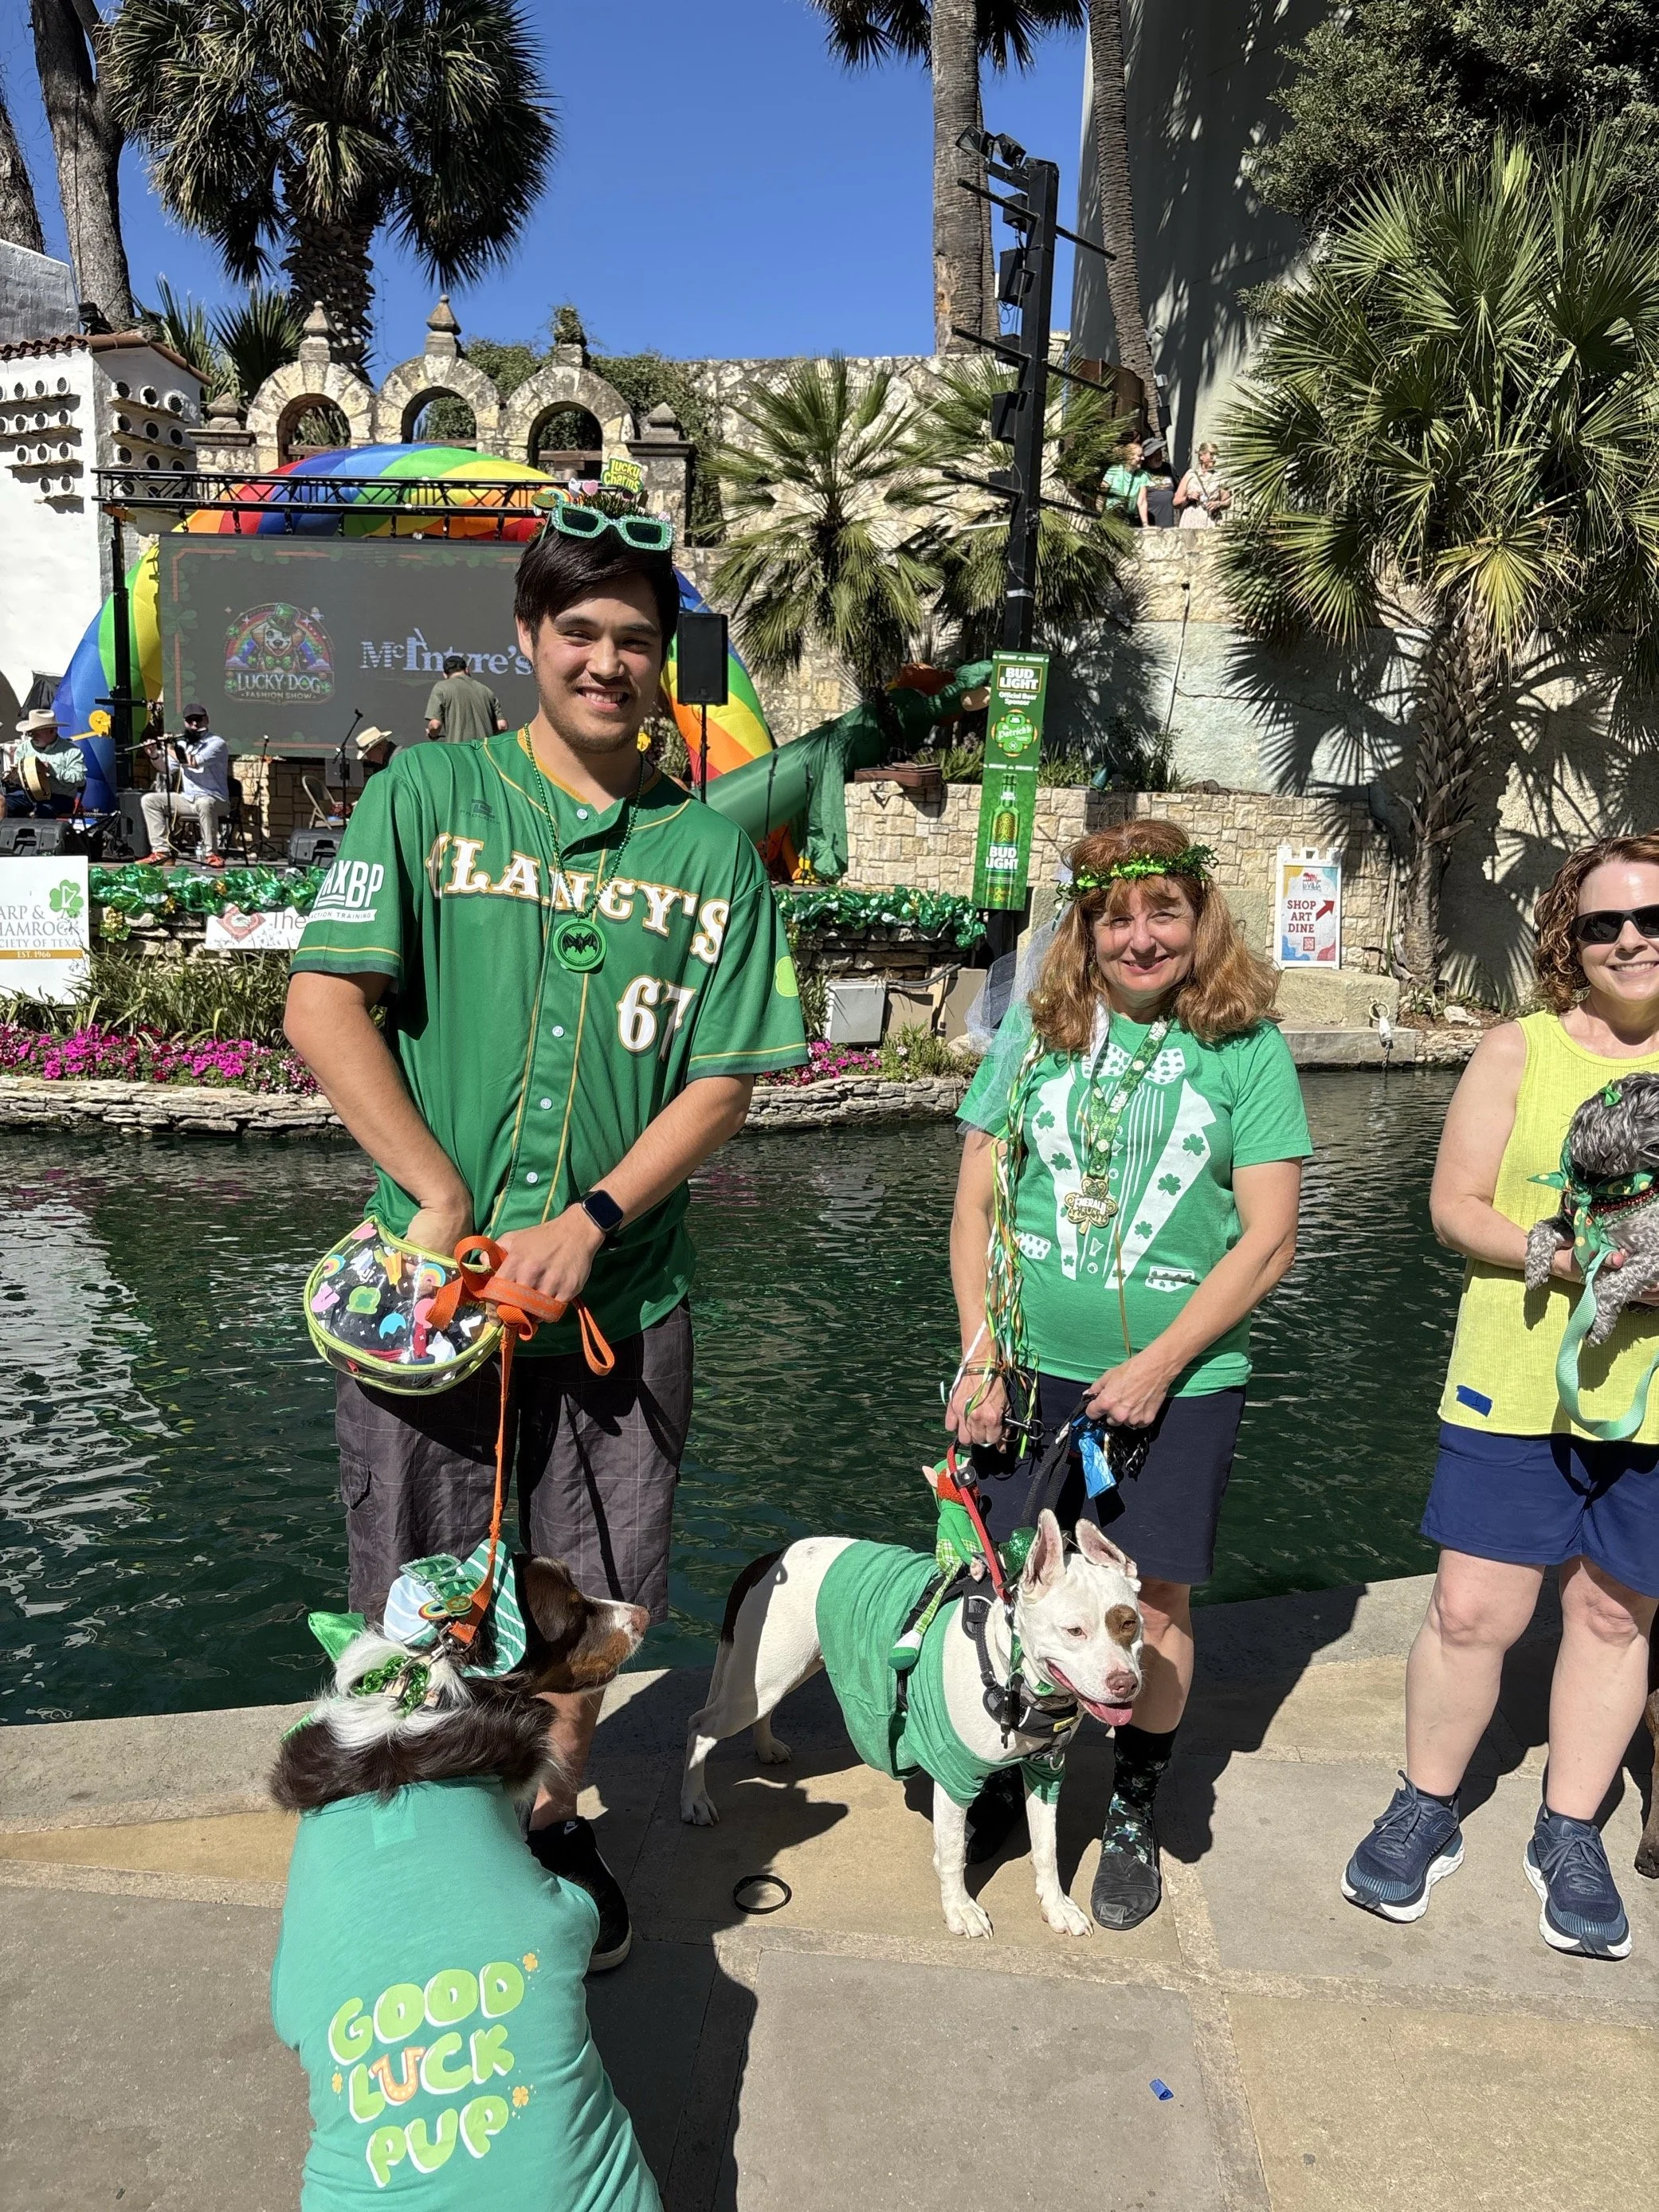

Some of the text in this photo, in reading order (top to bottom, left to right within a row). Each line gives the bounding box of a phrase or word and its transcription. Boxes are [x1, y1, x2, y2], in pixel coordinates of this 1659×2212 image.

[603, 472, 641, 493] Charms
[1005, 667, 1034, 679] BUD
[237, 673, 320, 693] LUCKY DOG
[999, 677, 1038, 690] LIGHT
[989, 846, 1017, 858] BUD
[985, 857, 1019, 870] LIGHT
[313, 860, 384, 908] AXBP
[33, 904, 45, 920] &
[1287, 900, 1316, 910] SHOP
[1290, 912, 1312, 922] ART
[1288, 924, 1315, 933] DINE
[33, 939, 46, 948] OF
[1073, 1198, 1107, 1215] EMERALD
[328, 1961, 524, 2065] GOOD
[349, 2024, 515, 2124] LUCK
[366, 2095, 509, 2188] PUP
